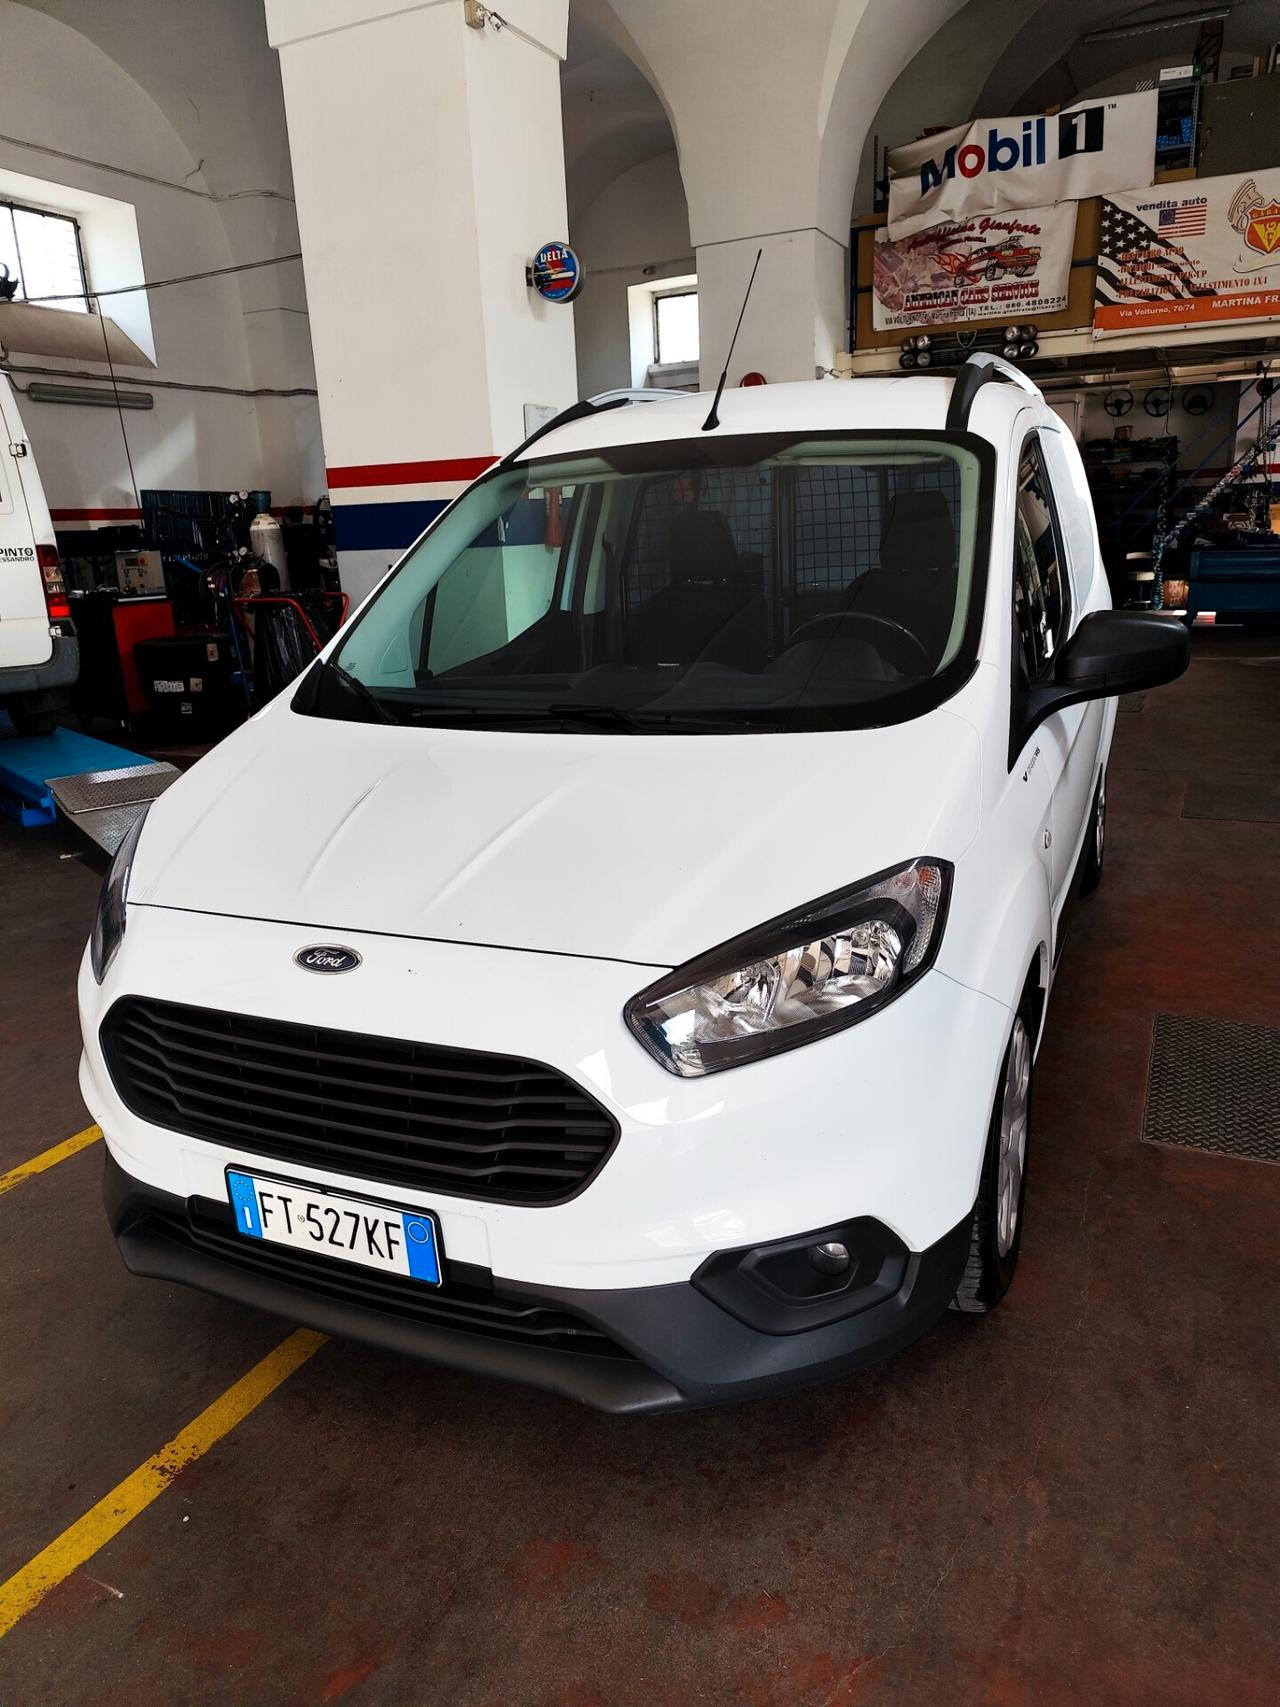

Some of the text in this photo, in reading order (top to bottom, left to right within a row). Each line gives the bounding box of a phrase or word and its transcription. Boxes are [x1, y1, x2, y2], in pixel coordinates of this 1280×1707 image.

[921, 117, 1046, 197] Mobil
[1136, 196, 1208, 212] vendita auto
[540, 249, 569, 263] DELTA
[1119, 309, 1133, 318] Via
[1211, 297, 1262, 309] MARTINA
[306, 948, 347, 967] Ford
[258, 1191, 402, 1260] FT 527KF
